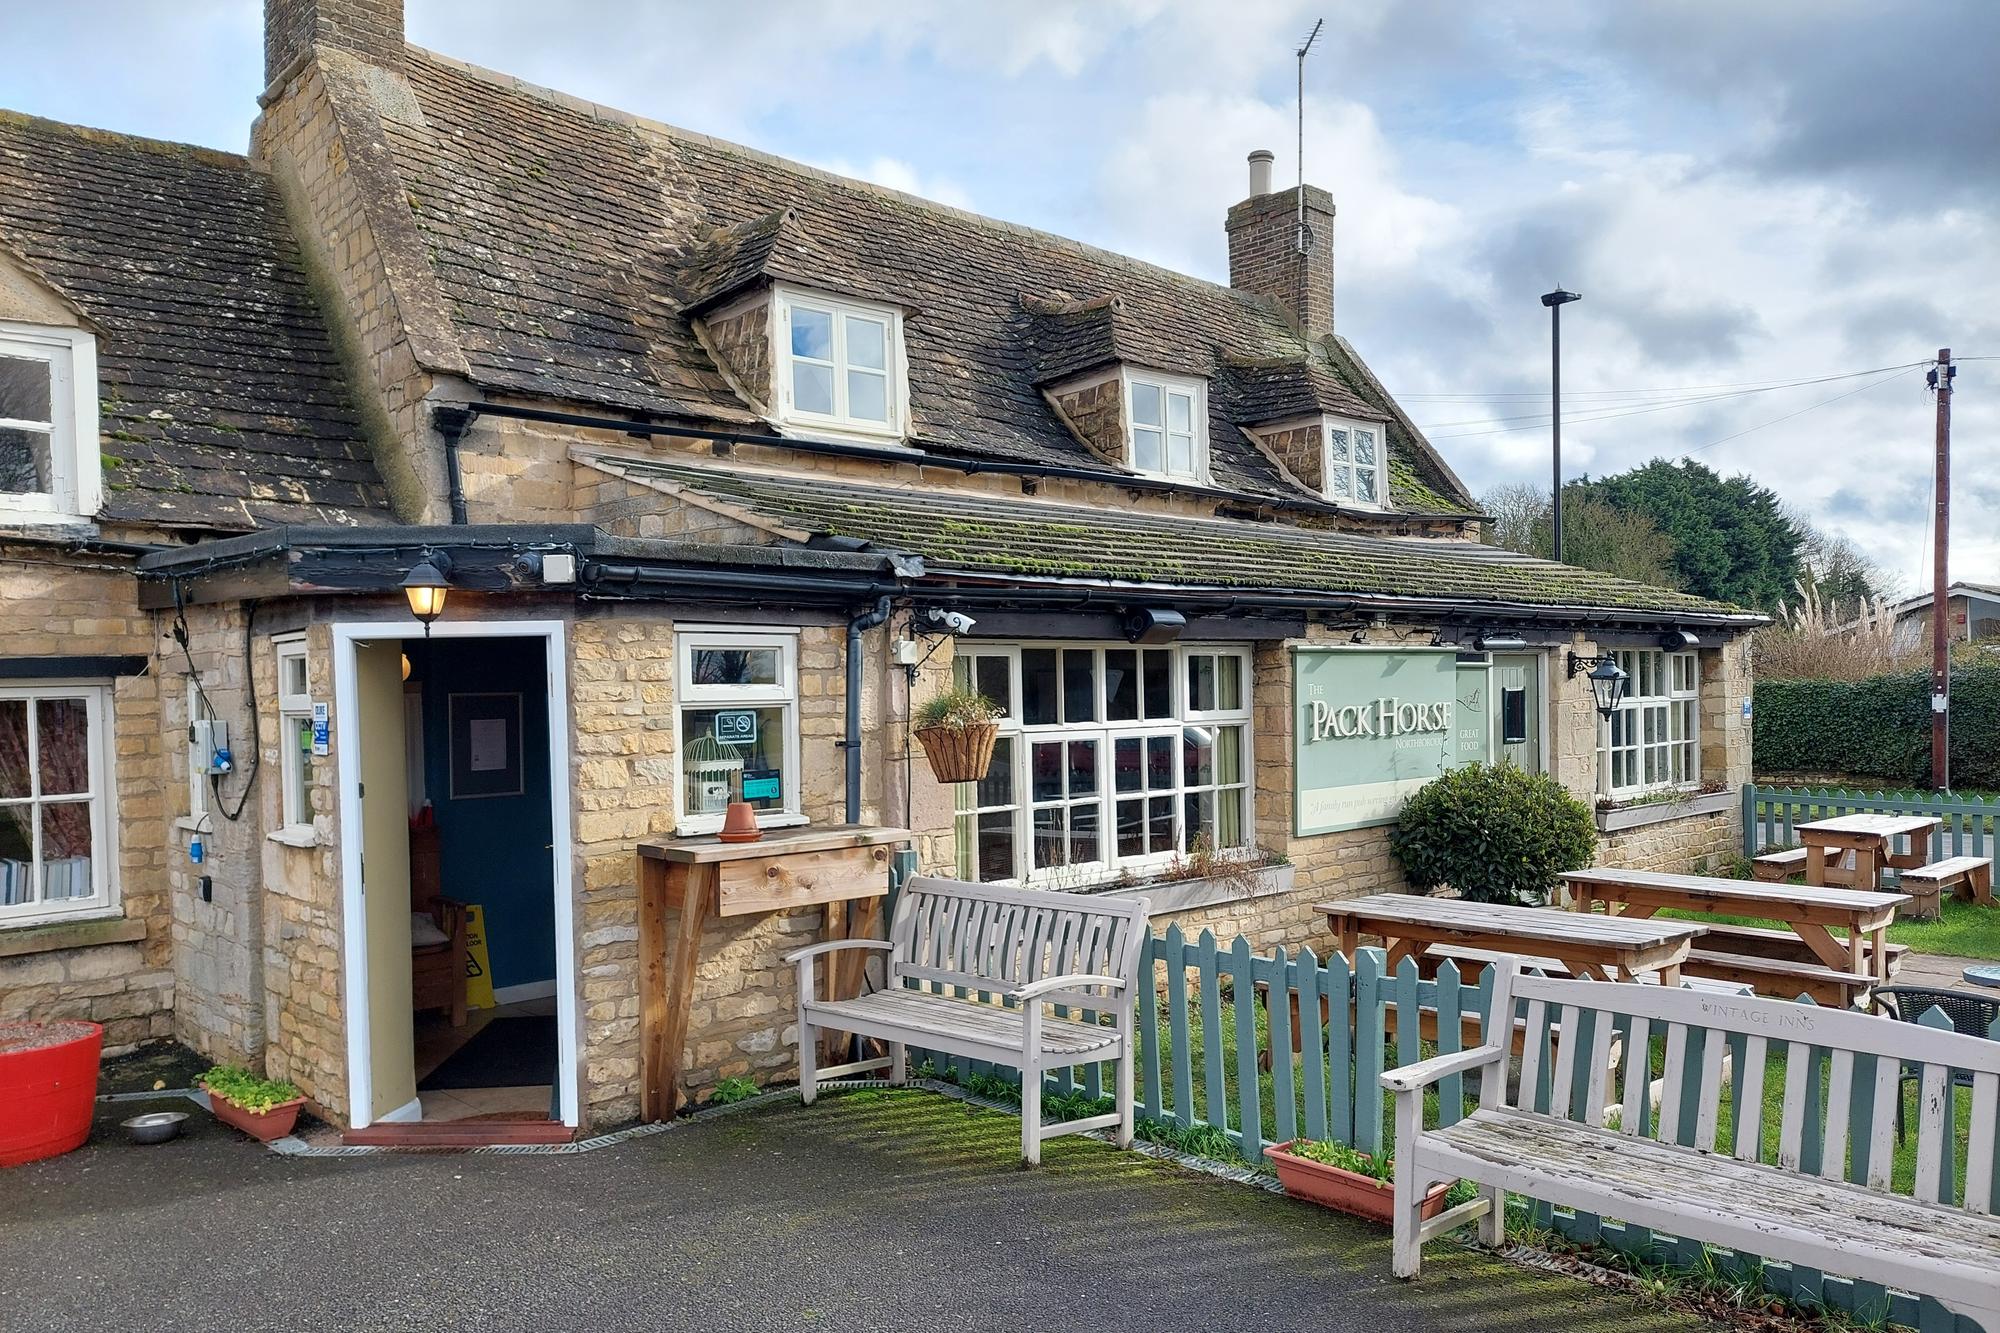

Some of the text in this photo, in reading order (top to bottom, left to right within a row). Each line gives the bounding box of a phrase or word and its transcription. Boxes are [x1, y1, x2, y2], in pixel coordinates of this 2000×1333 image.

[1308, 683, 1324, 696] THE
[1311, 697, 1453, 742] PACK HORSE
[1459, 729, 1479, 739] GREAT
[1461, 741, 1478, 751] FOOD
[1779, 1015, 1815, 1031] INNS
